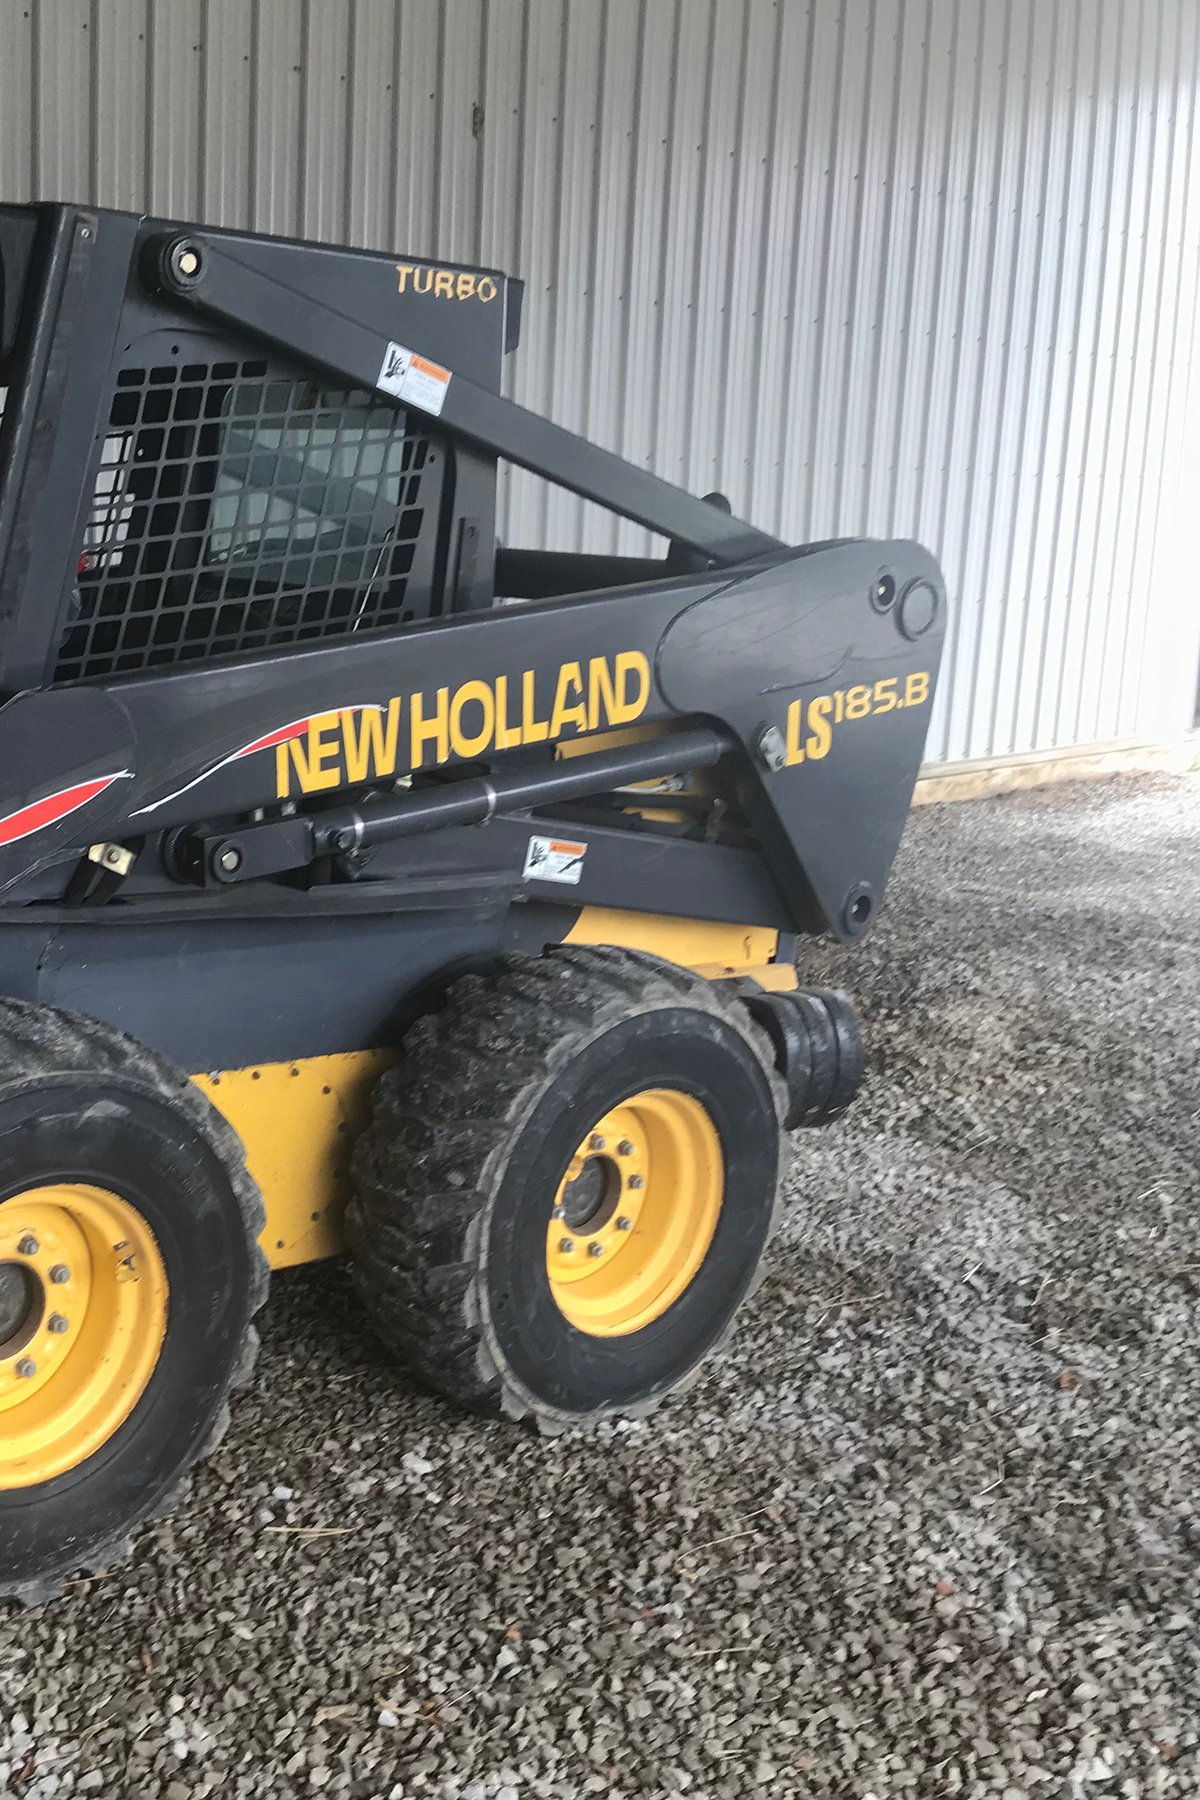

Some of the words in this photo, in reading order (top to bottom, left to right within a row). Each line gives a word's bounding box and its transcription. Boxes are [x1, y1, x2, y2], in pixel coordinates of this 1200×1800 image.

[396, 266, 497, 303] TURBO
[276, 696, 401, 798] NEW
[410, 650, 650, 769] HOLLAND
